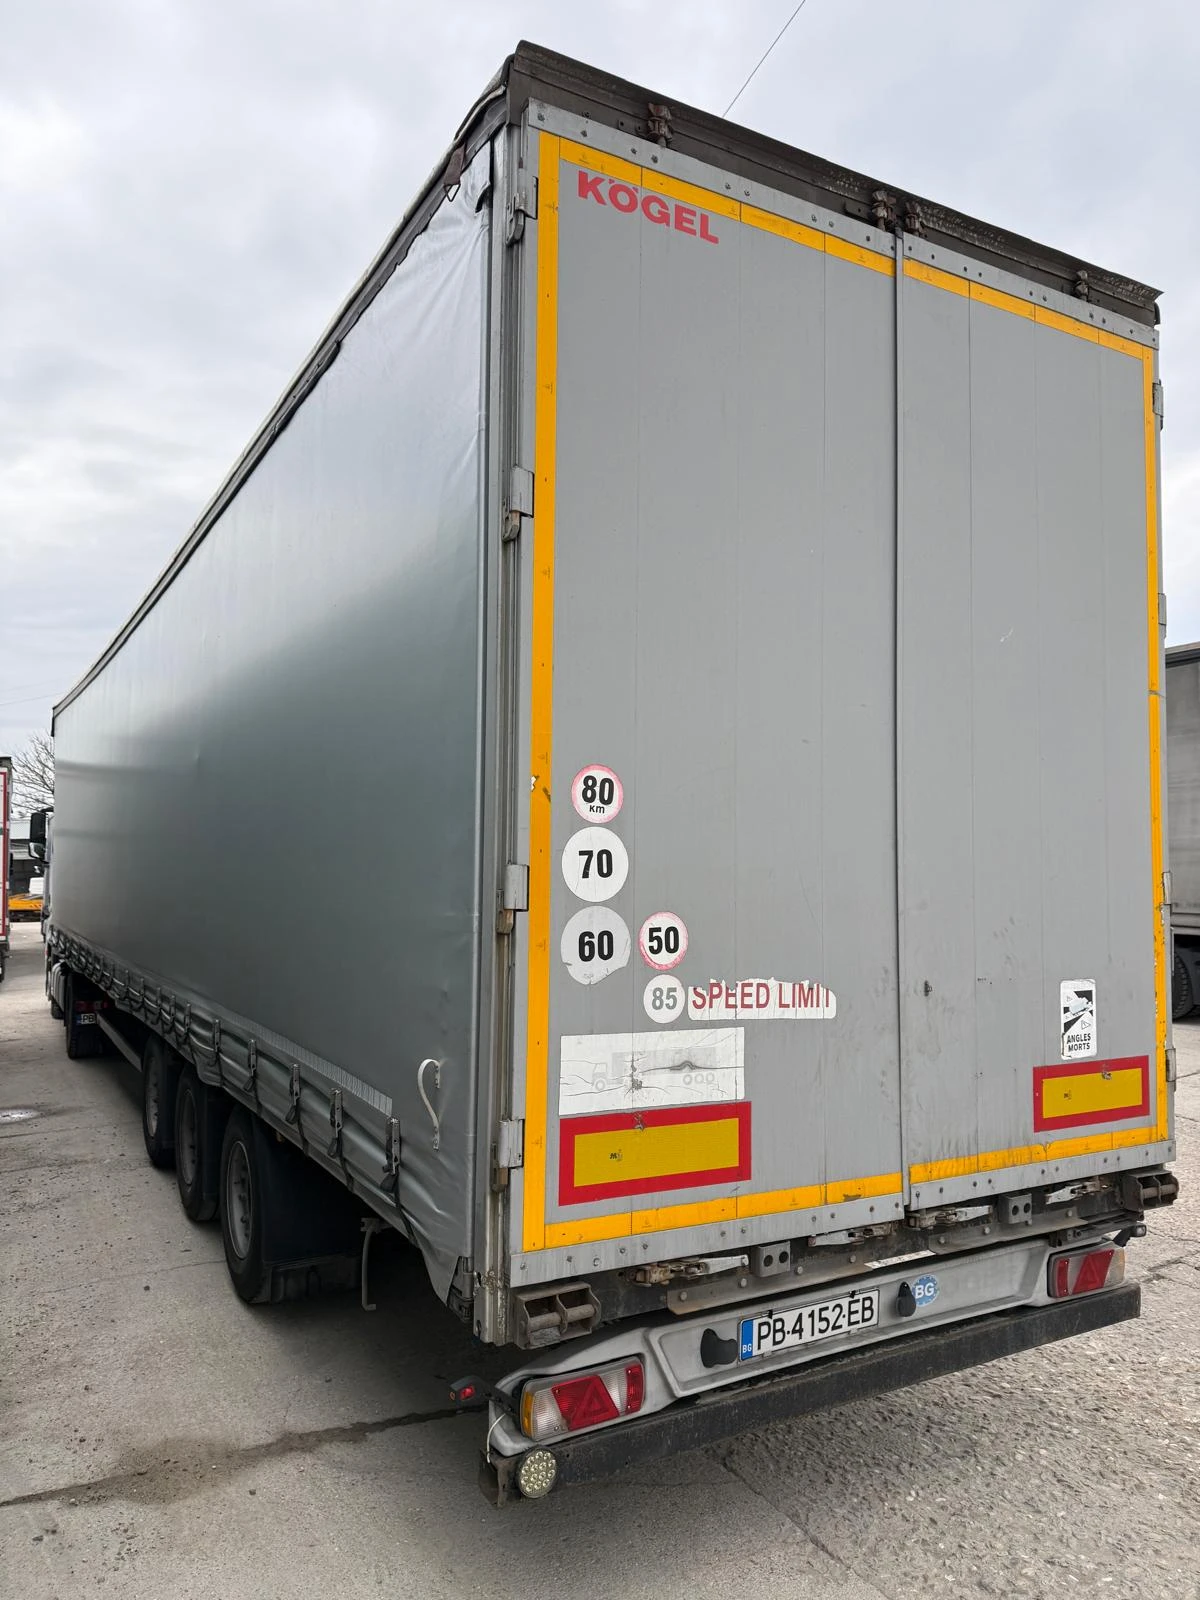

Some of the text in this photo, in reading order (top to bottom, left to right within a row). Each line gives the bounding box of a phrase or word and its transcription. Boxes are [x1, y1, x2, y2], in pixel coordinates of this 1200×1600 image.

[577, 170, 720, 245] KÖGEL
[581, 775, 615, 806] 80
[578, 849, 614, 879] 70
[578, 930, 614, 962] 60
[648, 926, 680, 955] 50
[651, 987, 678, 1010] 85
[692, 982, 770, 1010] SPEED
[1066, 1033, 1092, 1044] ANGLES
[1067, 1043, 1091, 1052] MORTS
[915, 1282, 935, 1299] BG
[742, 1343, 752, 1353] BG
